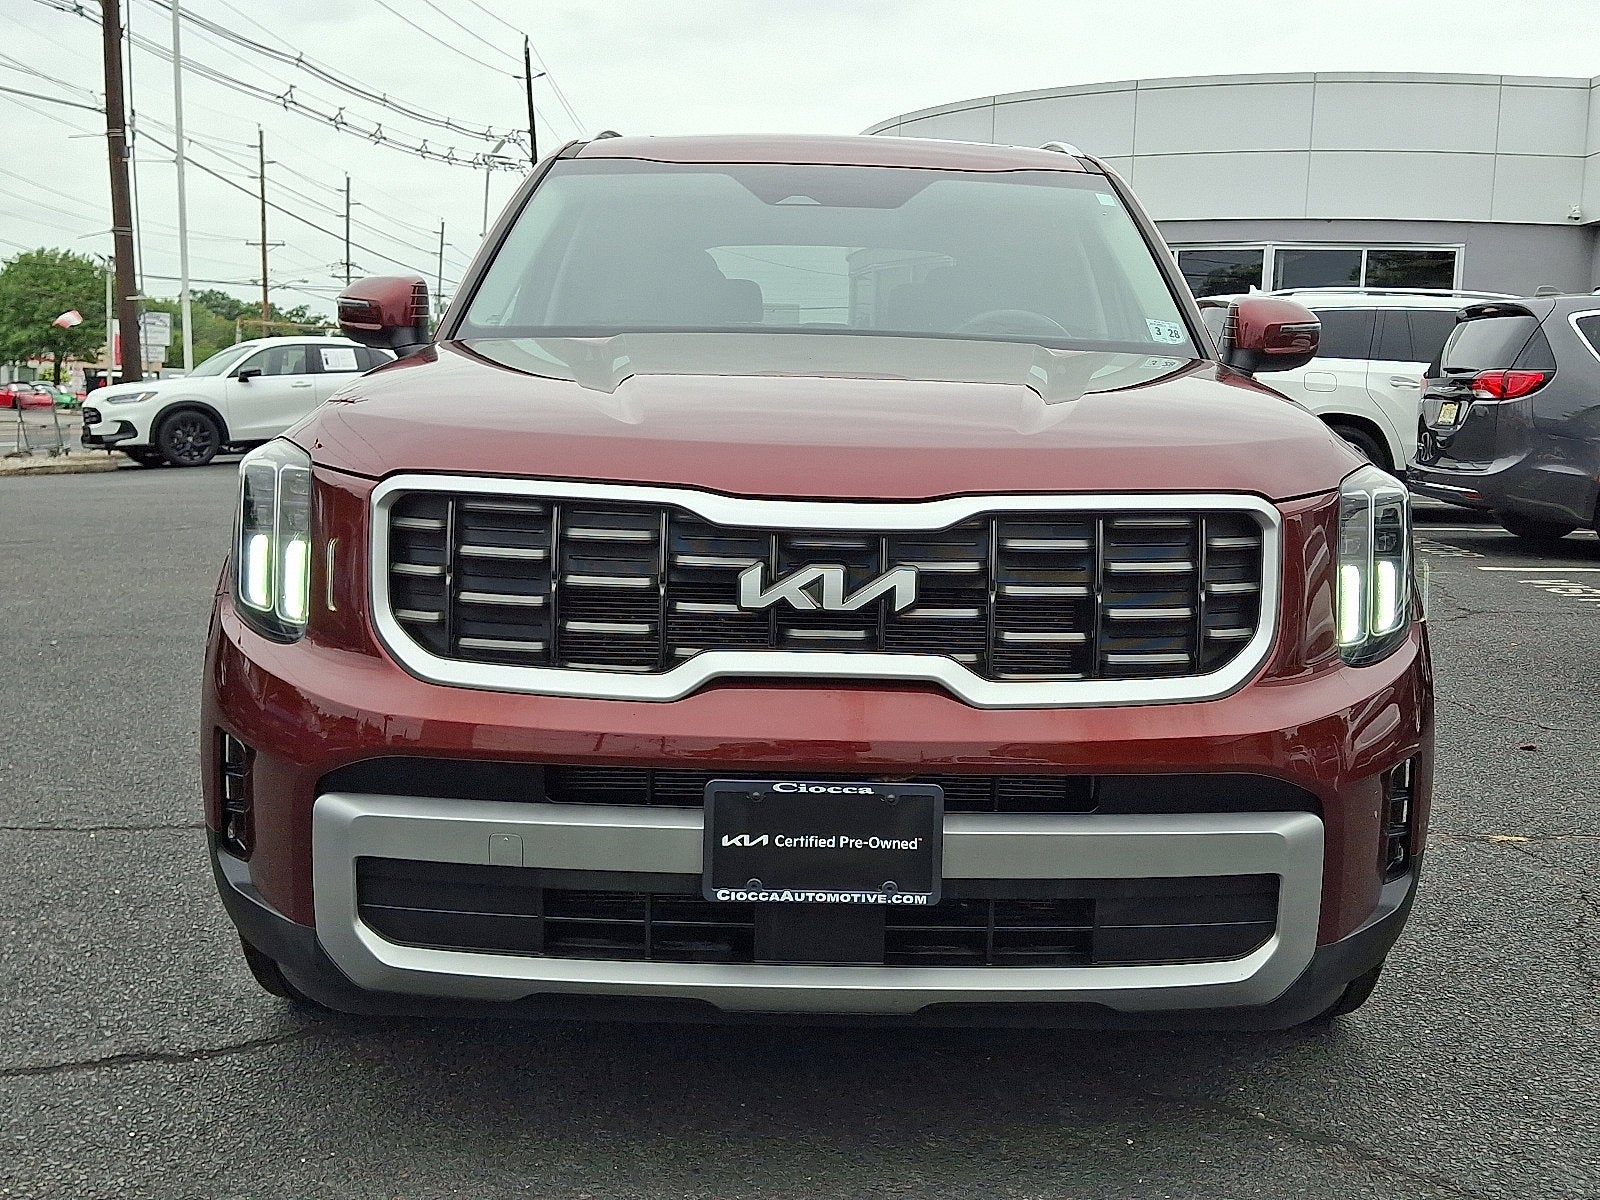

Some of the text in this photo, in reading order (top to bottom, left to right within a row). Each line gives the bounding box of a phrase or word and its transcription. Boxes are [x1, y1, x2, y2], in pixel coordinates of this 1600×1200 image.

[1154, 326, 1181, 339] 3 28
[738, 562, 919, 612] KIA
[772, 782, 875, 795] Ciocca
[721, 834, 918, 851] KIA Certified Pre-Owned
